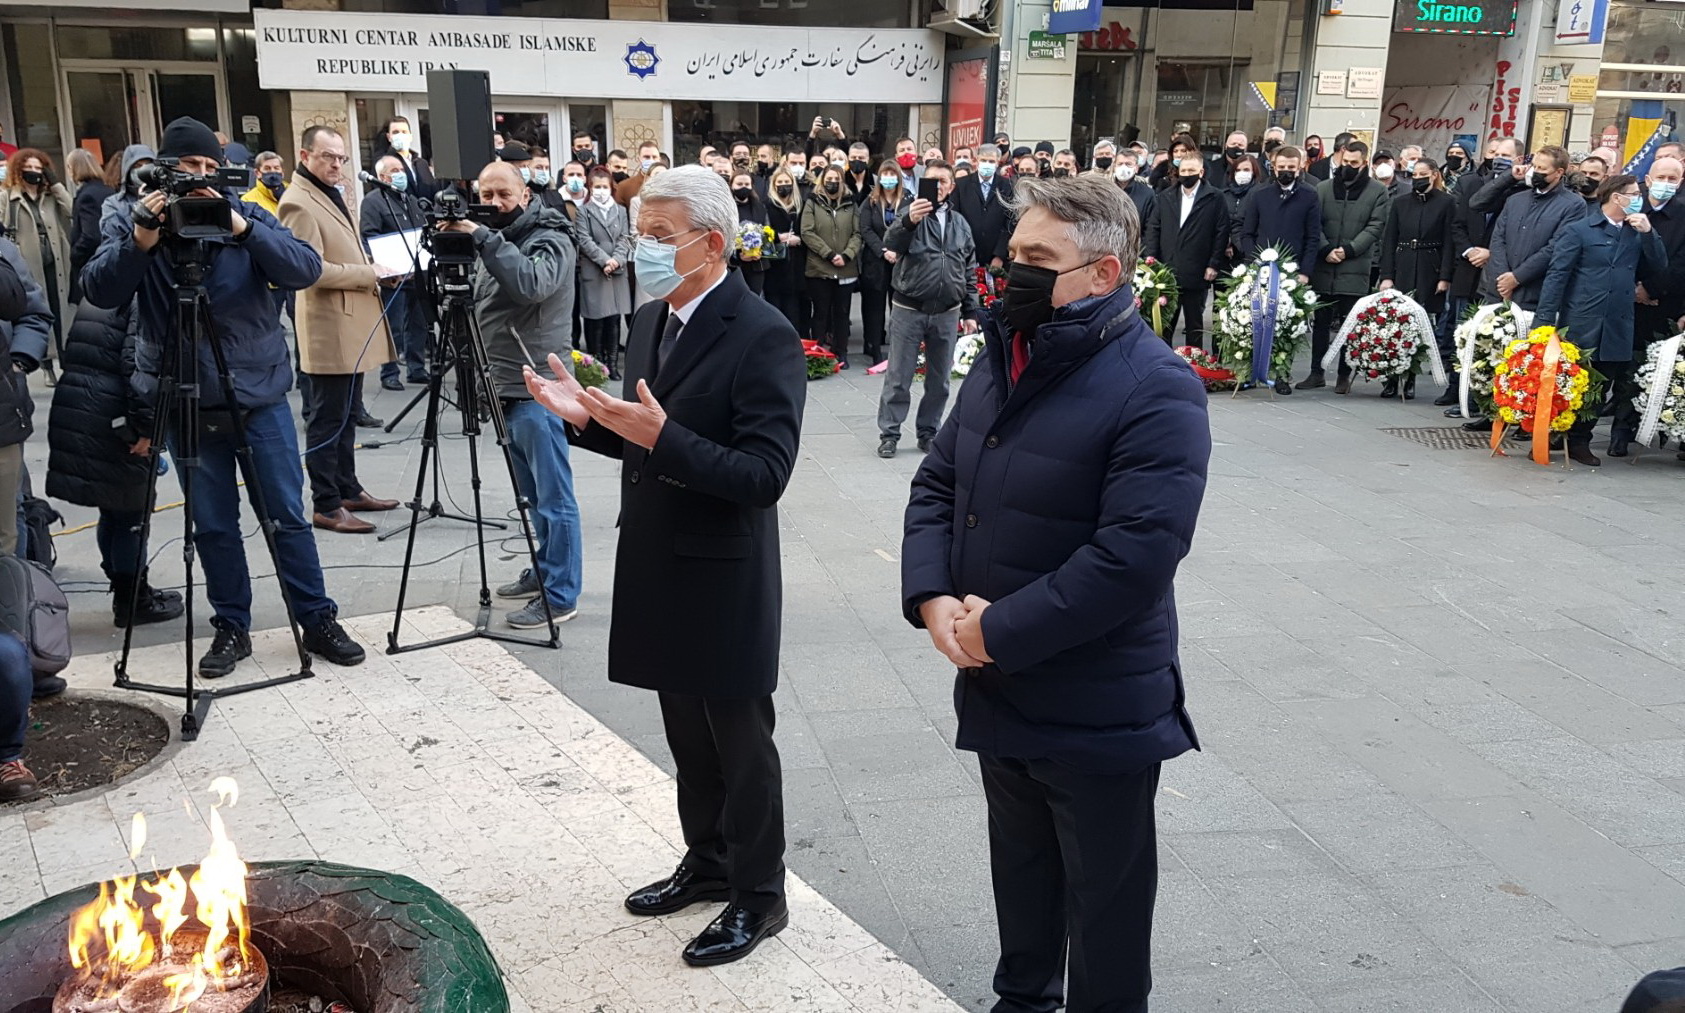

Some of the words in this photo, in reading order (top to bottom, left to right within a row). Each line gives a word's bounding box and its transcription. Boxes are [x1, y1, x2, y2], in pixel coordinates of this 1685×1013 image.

[1416, 0, 1482, 23] Sirano
[263, 27, 348, 45] KULTURNI
[355, 30, 419, 47] CENTAR
[428, 32, 512, 50] AMBASADE
[519, 35, 597, 52] ISLAMSKE
[1031, 40, 1062, 48] MARŠALA
[317, 59, 410, 76] REPUBLIKE
[687, 50, 720, 80] ایران
[722, 49, 757, 75] اسلامی
[754, 48, 798, 77] جمهوری
[801, 47, 843, 67] سفارت
[953, 125, 980, 147] UVIJEK
